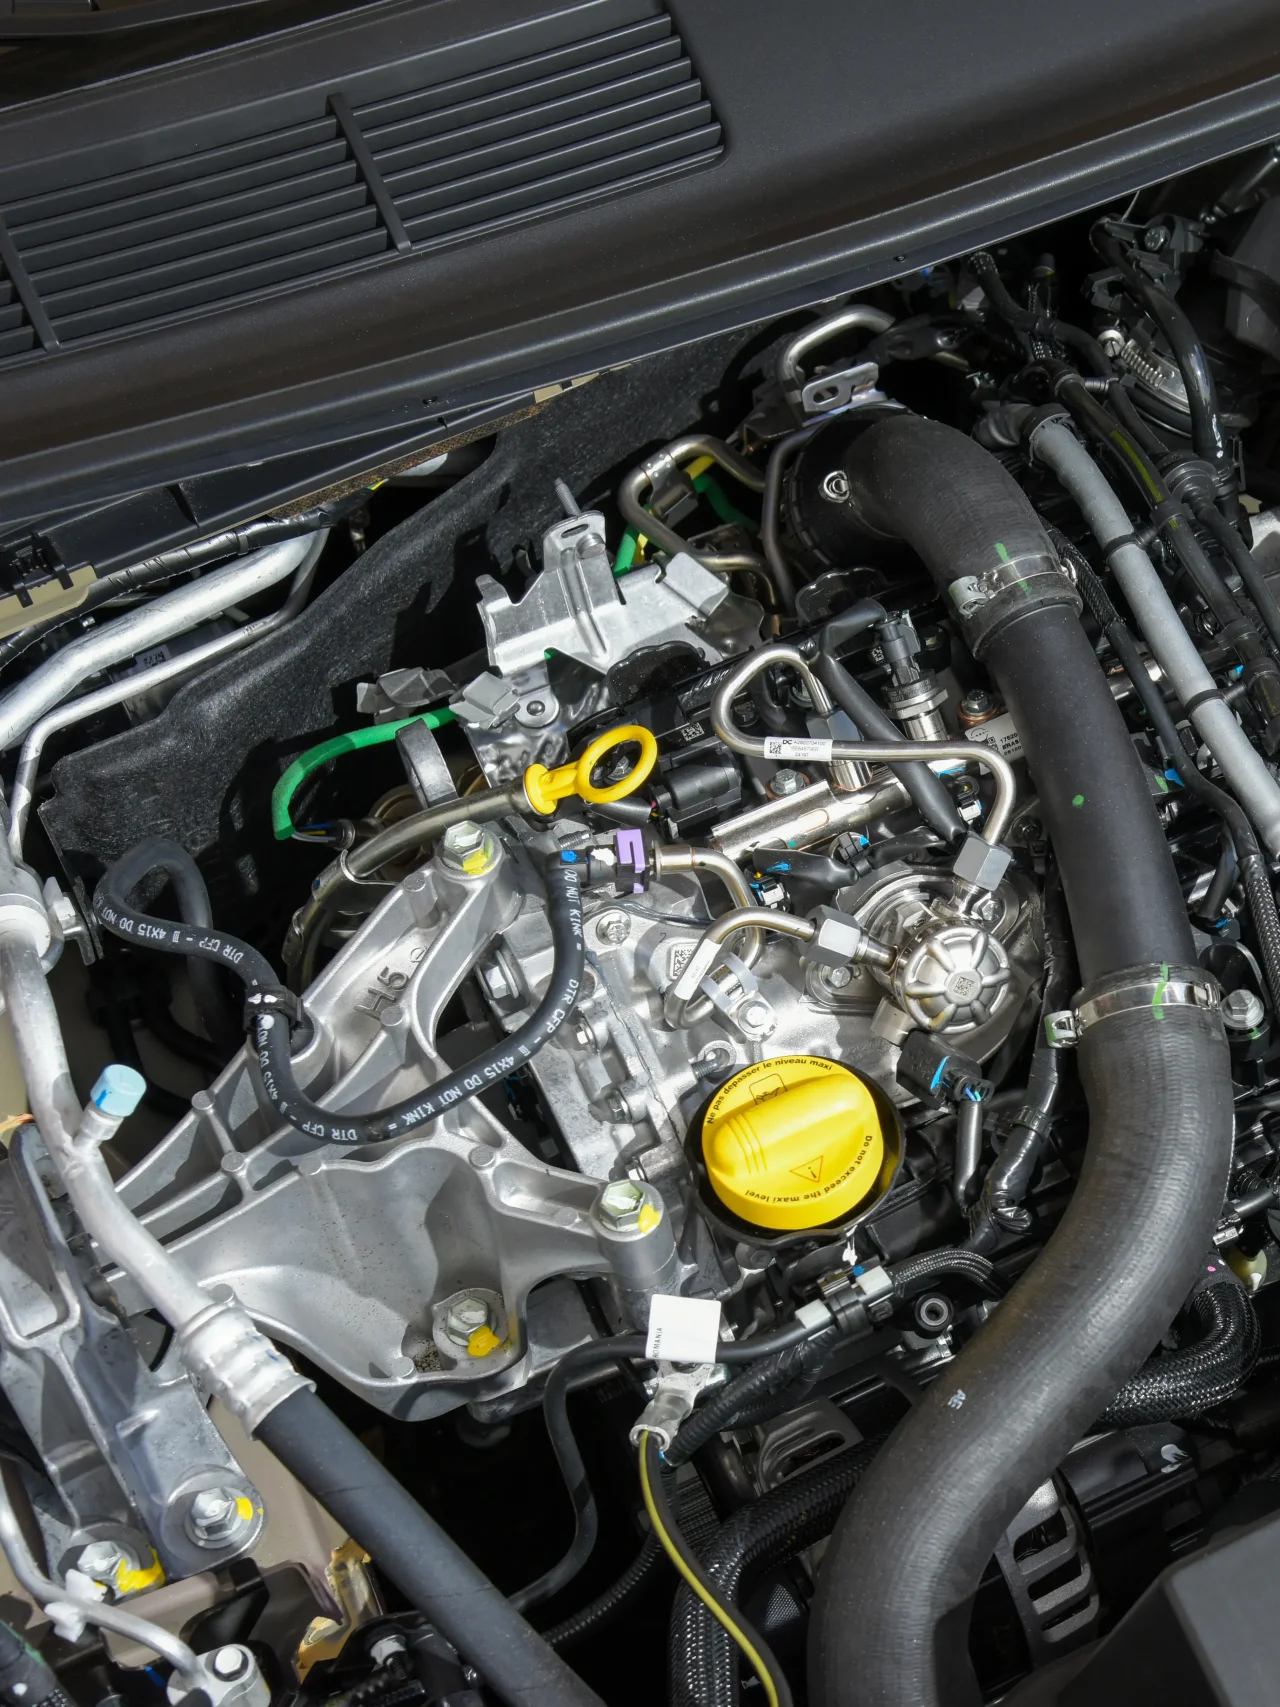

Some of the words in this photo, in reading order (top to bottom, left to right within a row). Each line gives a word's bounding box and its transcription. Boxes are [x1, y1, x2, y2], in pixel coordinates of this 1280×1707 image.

[100, 906, 118, 924] NOT
[569, 908, 583, 937] KINK
[119, 917, 134, 932] DO
[137, 924, 167, 940] 4X15
[222, 947, 245, 964] DTR
[561, 978, 579, 1005] DTR
[546, 1008, 565, 1034] CFP
[484, 1056, 515, 1078] 4X15
[464, 1074, 483, 1090] DO
[438, 1086, 462, 1106] NOT
[706, 1111, 716, 1124] Ne
[713, 1096, 725, 1112] pas
[763, 1061, 772, 1069] le
[774, 1058, 807, 1066] niveau
[809, 1060, 834, 1071] maxi
[401, 1102, 435, 1125] KINK
[302, 1121, 325, 1137] CFP
[331, 1128, 358, 1141] DTR
[863, 1135, 873, 1147] Do
[854, 1149, 866, 1165] not
[823, 1166, 855, 1193] exceed
[744, 1189, 770, 1203] level
[772, 1196, 800, 1204] maxi
[803, 1190, 822, 1200] the
